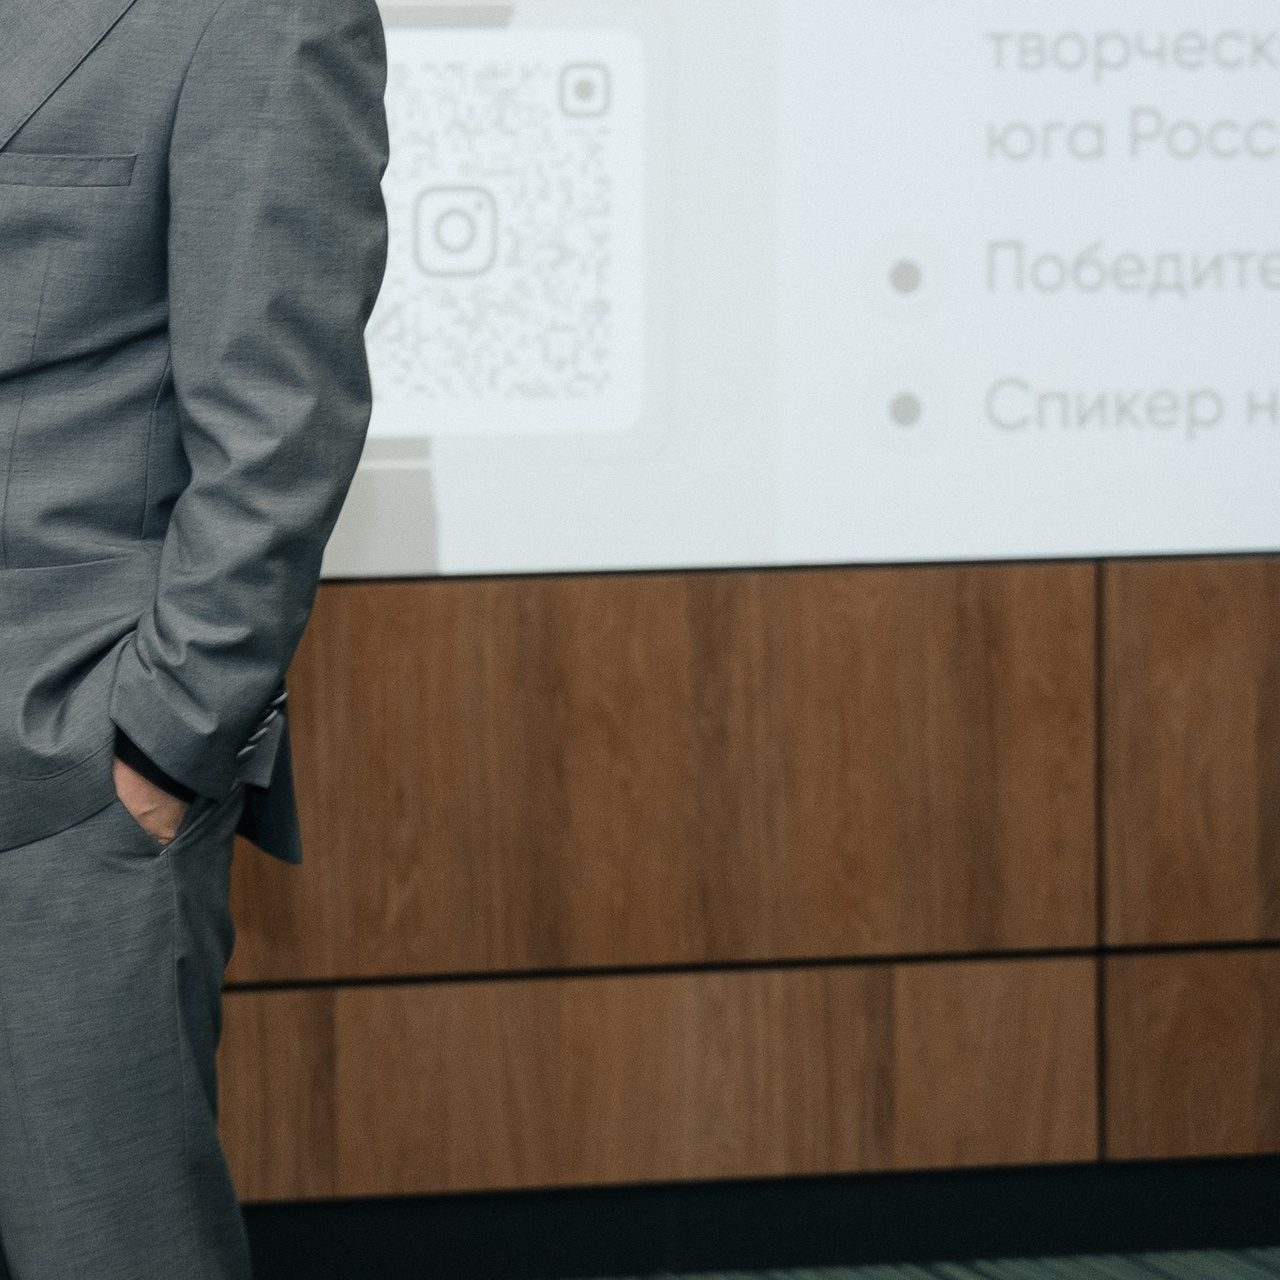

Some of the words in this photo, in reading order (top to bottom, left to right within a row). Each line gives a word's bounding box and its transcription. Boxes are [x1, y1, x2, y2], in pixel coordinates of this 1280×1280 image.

[984, 29, 1280, 86] творческ
[986, 120, 1106, 162] юга
[1129, 104, 1280, 161] Росс
[984, 376, 1225, 442] Спикер
